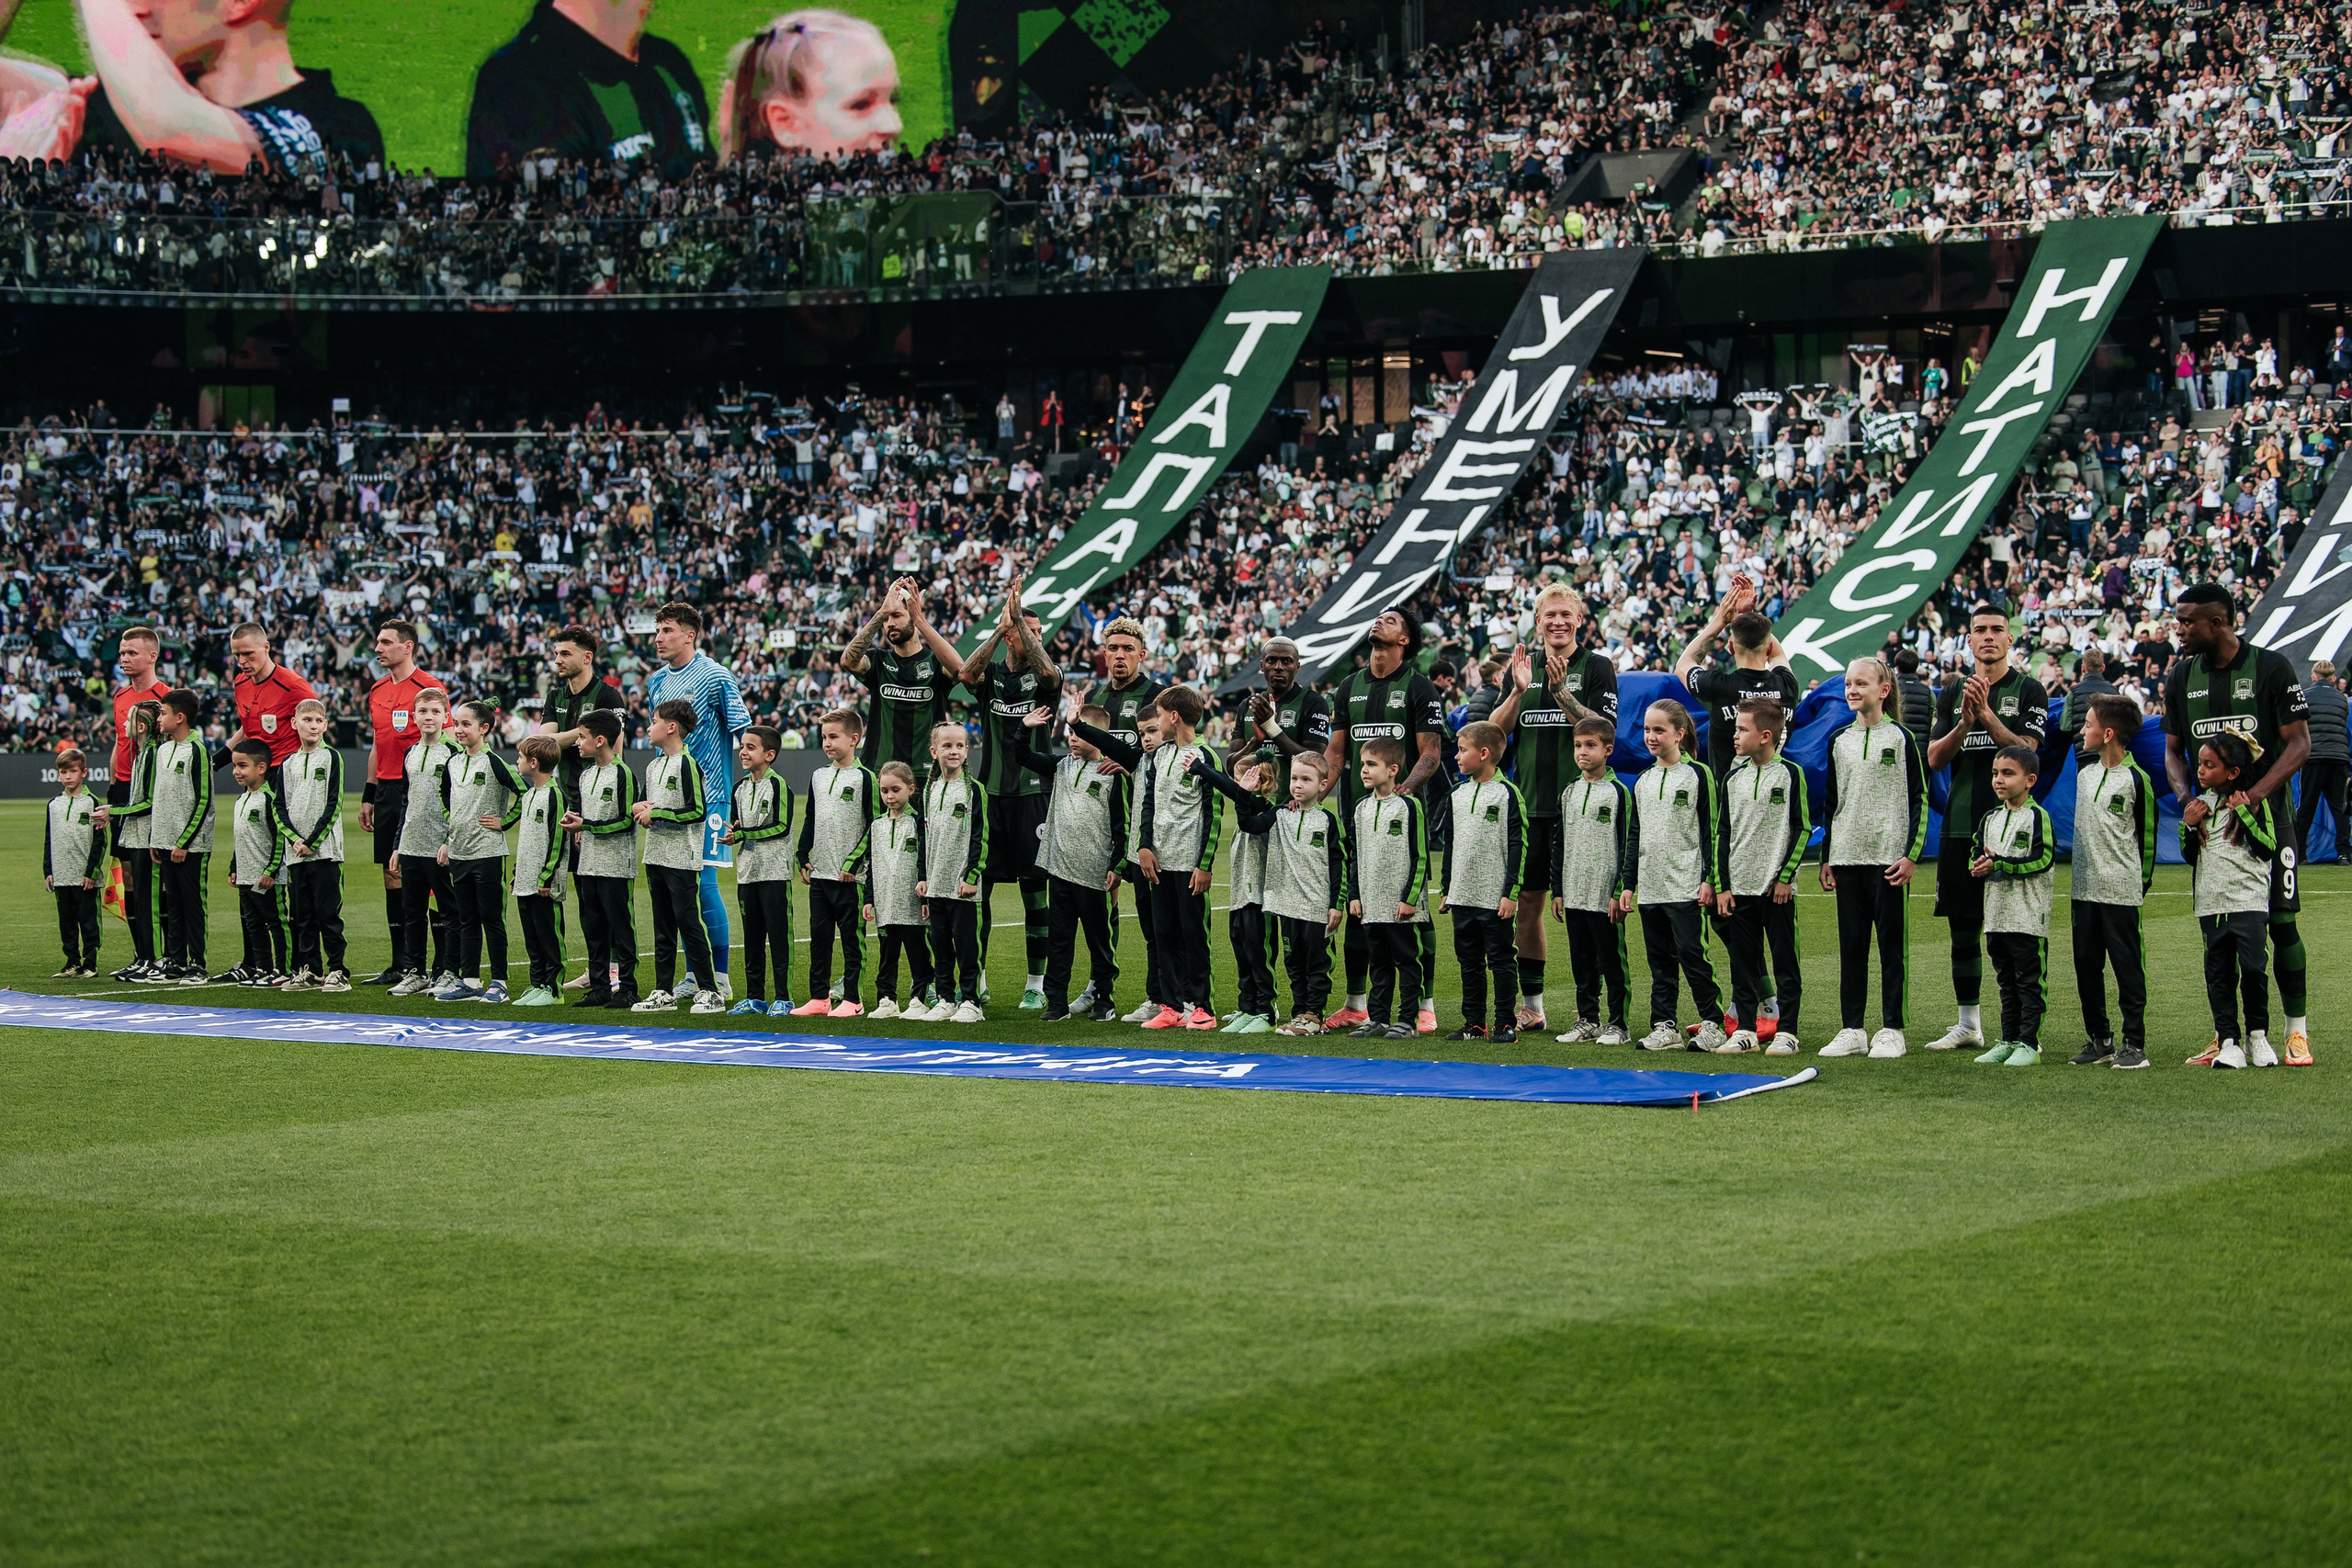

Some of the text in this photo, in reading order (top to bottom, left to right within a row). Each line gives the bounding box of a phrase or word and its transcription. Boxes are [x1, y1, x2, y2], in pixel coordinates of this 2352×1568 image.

[1766, 257, 2129, 671] НАТИСК
[883, 686, 922, 699] WINLINE
[2188, 689, 2209, 699] OZON
[992, 701, 1028, 714] WINLINE
[1525, 712, 1566, 724] WINLINE
[1353, 727, 1392, 738] WINLINE
[40, 767, 109, 783] 10 101
[709, 831, 718, 855] 1
[2283, 869, 2295, 899] 9
